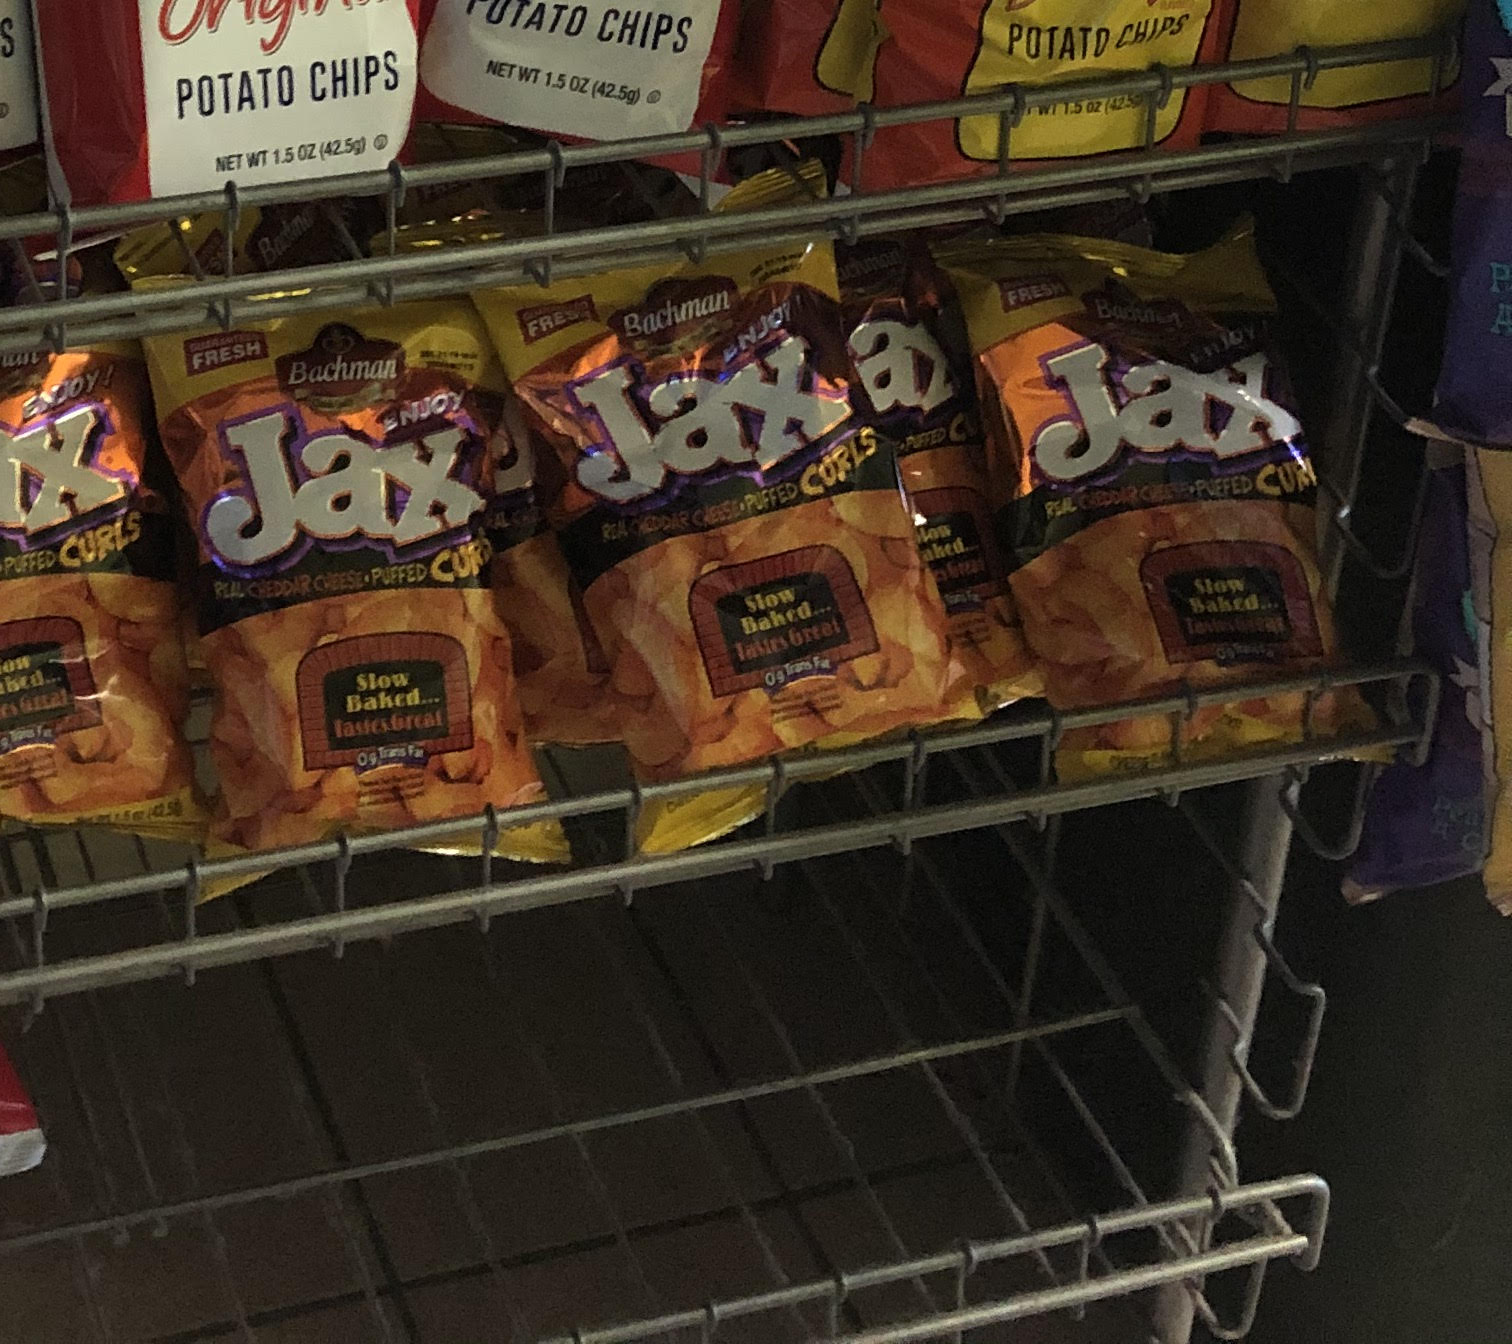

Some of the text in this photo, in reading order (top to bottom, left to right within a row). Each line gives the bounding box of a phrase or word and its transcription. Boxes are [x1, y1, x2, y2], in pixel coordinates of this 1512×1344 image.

[599, 10, 692, 54] CHIPS
[1008, 13, 1190, 60] POTATO CHIPS
[176, 50, 399, 119] POTATO CHIPS
[624, 291, 729, 339] Bachman
[1008, 279, 1065, 309] FRESH
[191, 340, 261, 370] FRESH
[288, 355, 397, 385] Bachman
[575, 335, 855, 494] Jax
[1034, 343, 1301, 481] Jax
[206, 412, 486, 565] Jax
[745, 586, 795, 613] Slow
[356, 669, 411, 691] Slow
